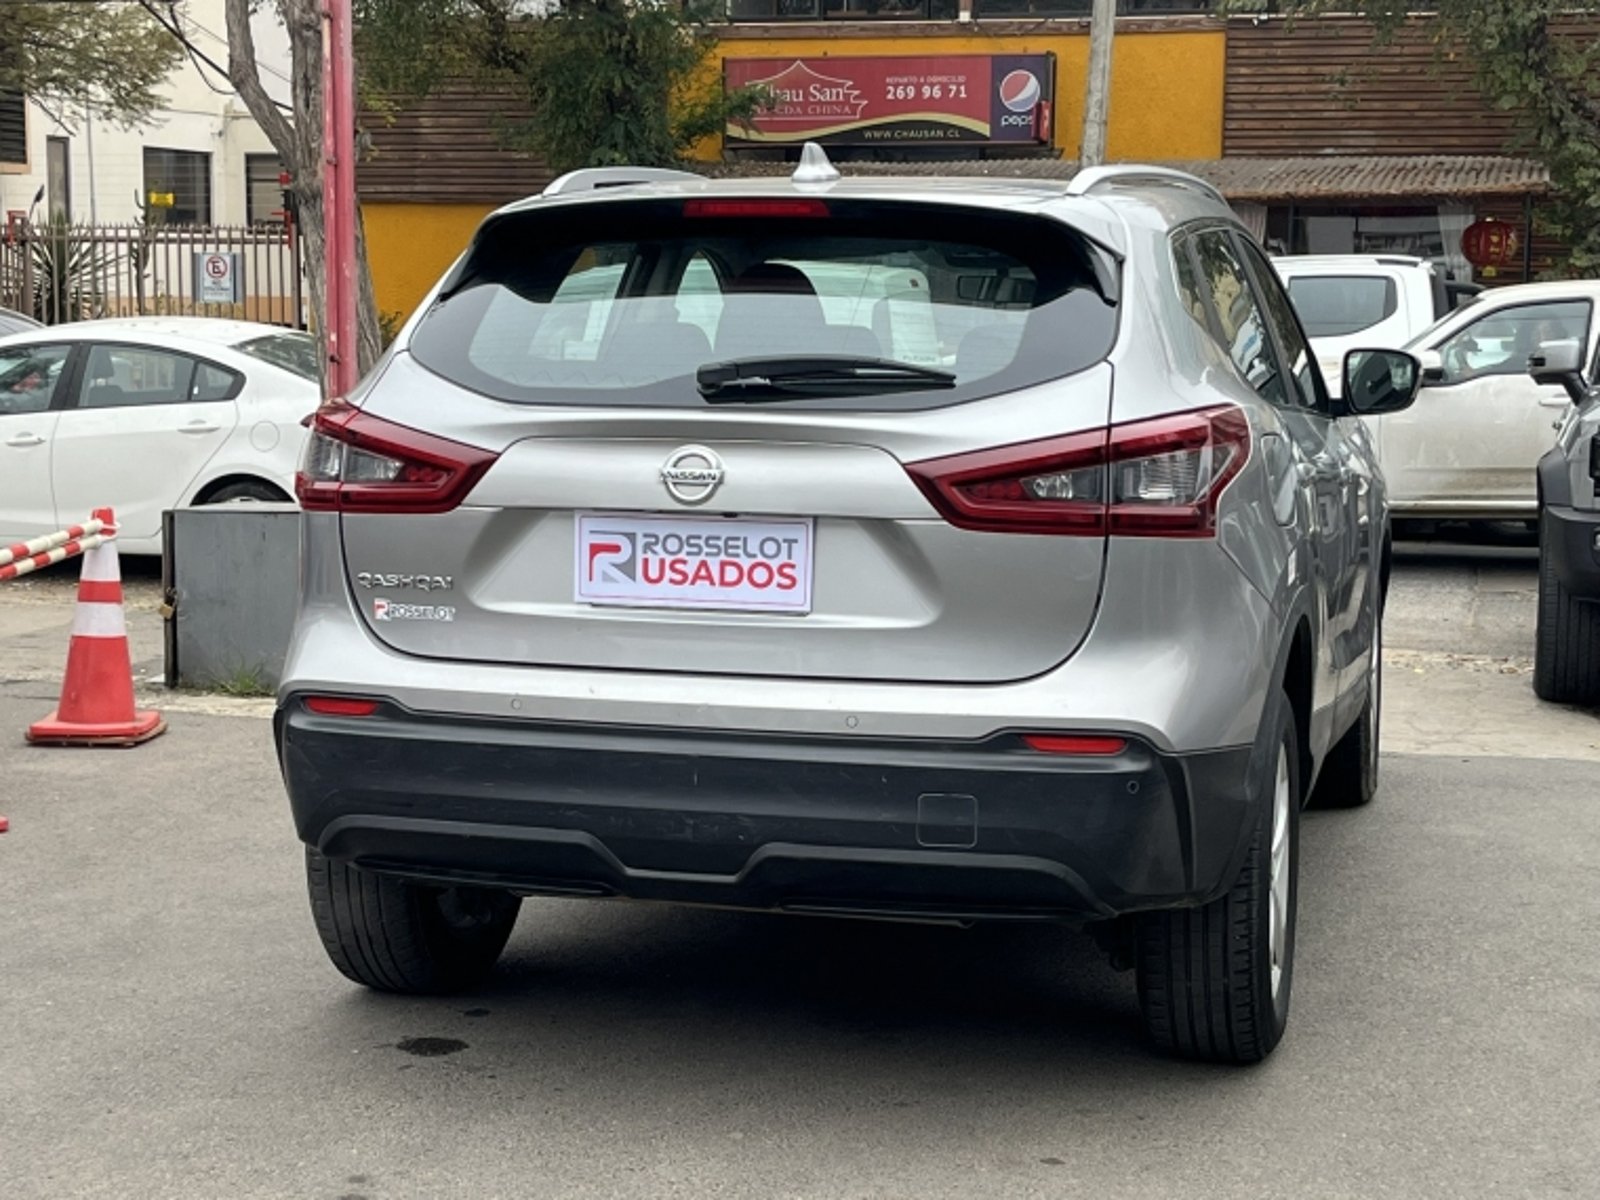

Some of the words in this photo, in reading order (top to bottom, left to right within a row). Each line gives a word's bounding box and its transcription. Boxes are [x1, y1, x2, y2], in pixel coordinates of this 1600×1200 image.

[808, 83, 845, 102] San
[886, 85, 915, 100] 269
[921, 84, 942, 99] 96
[948, 84, 967, 98] 71
[807, 105, 852, 114] CHINA
[666, 470, 718, 481] NISSAN
[641, 532, 799, 561] ROSSELOT
[357, 572, 453, 592] QASHQAI
[641, 557, 798, 590] USADOS
